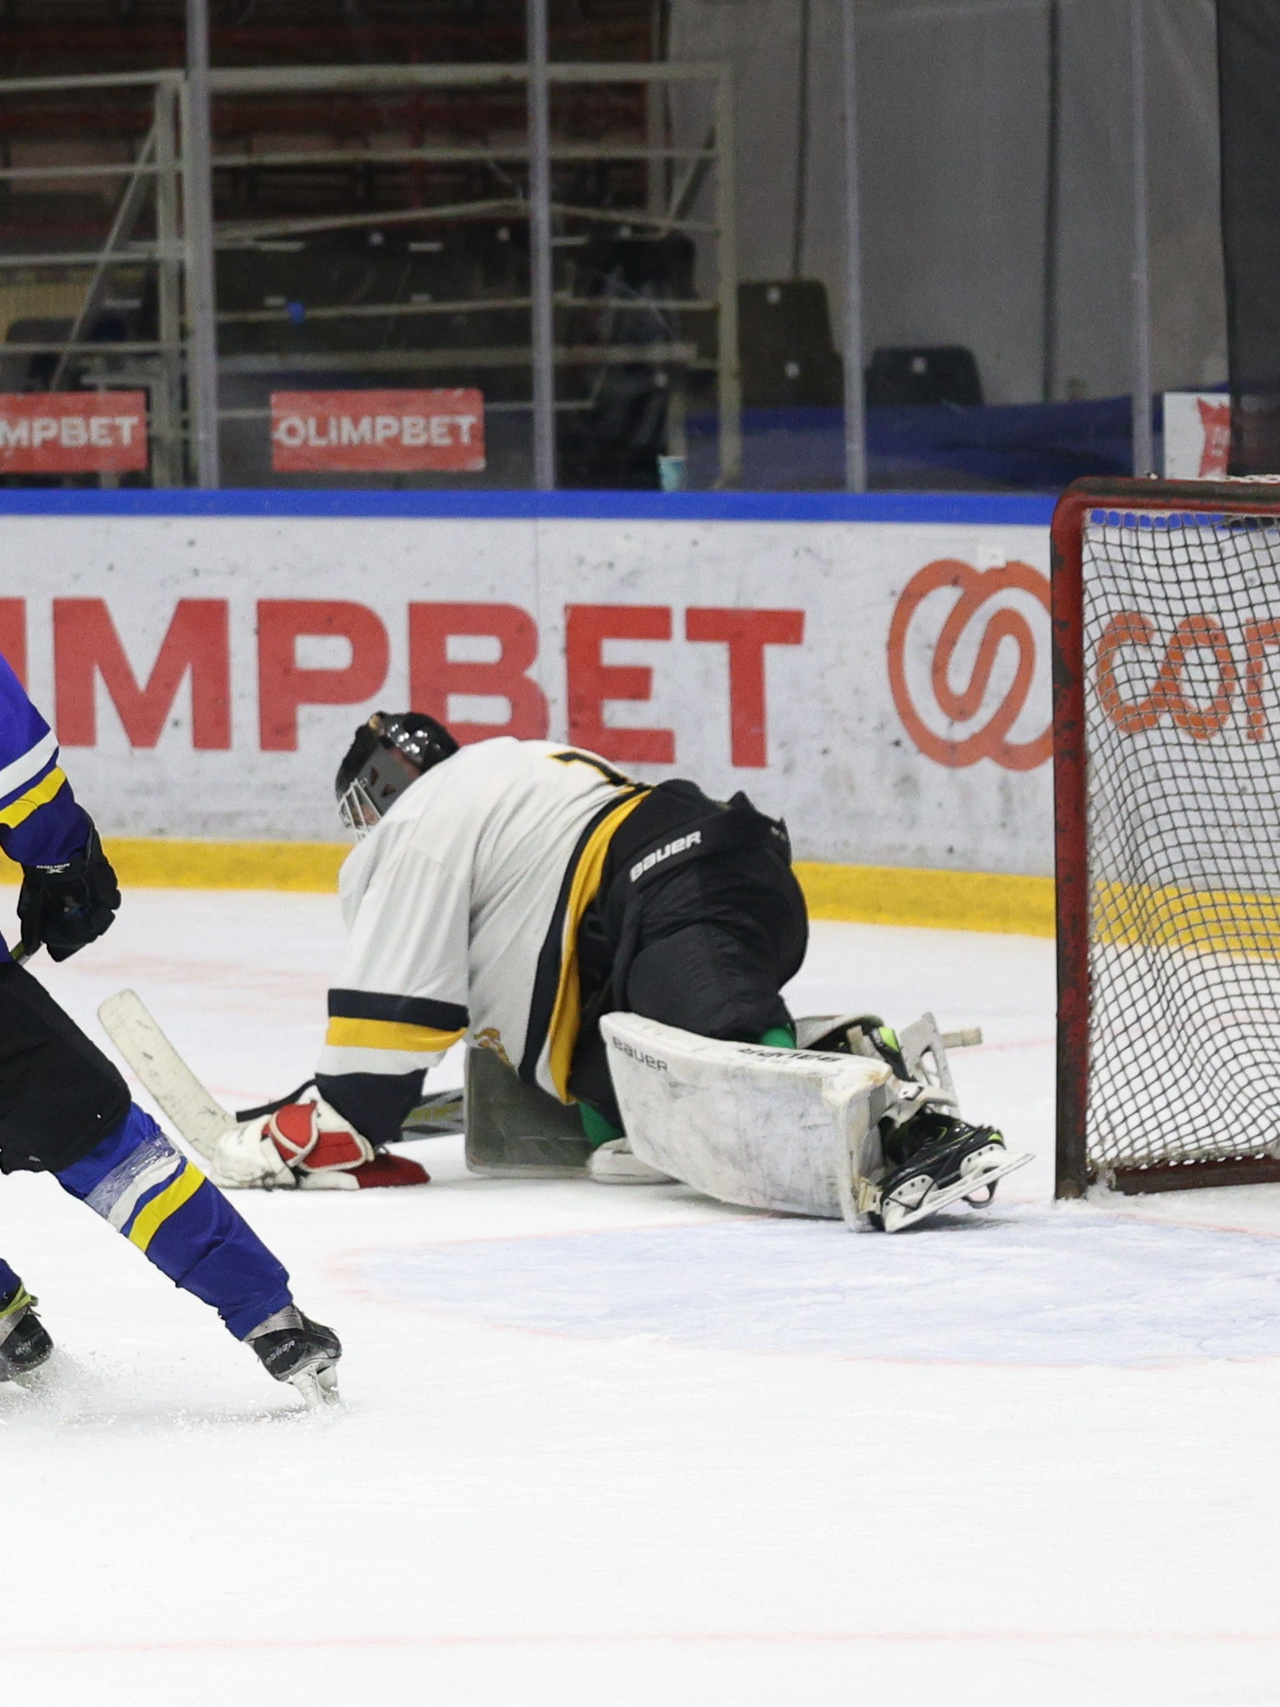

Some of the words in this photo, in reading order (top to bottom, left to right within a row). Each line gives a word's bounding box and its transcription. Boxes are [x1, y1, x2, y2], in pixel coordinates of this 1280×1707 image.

[278, 415, 477, 447] OLIMPBET
[629, 830, 703, 883] BAUER
[612, 1035, 668, 1072] BAUER
